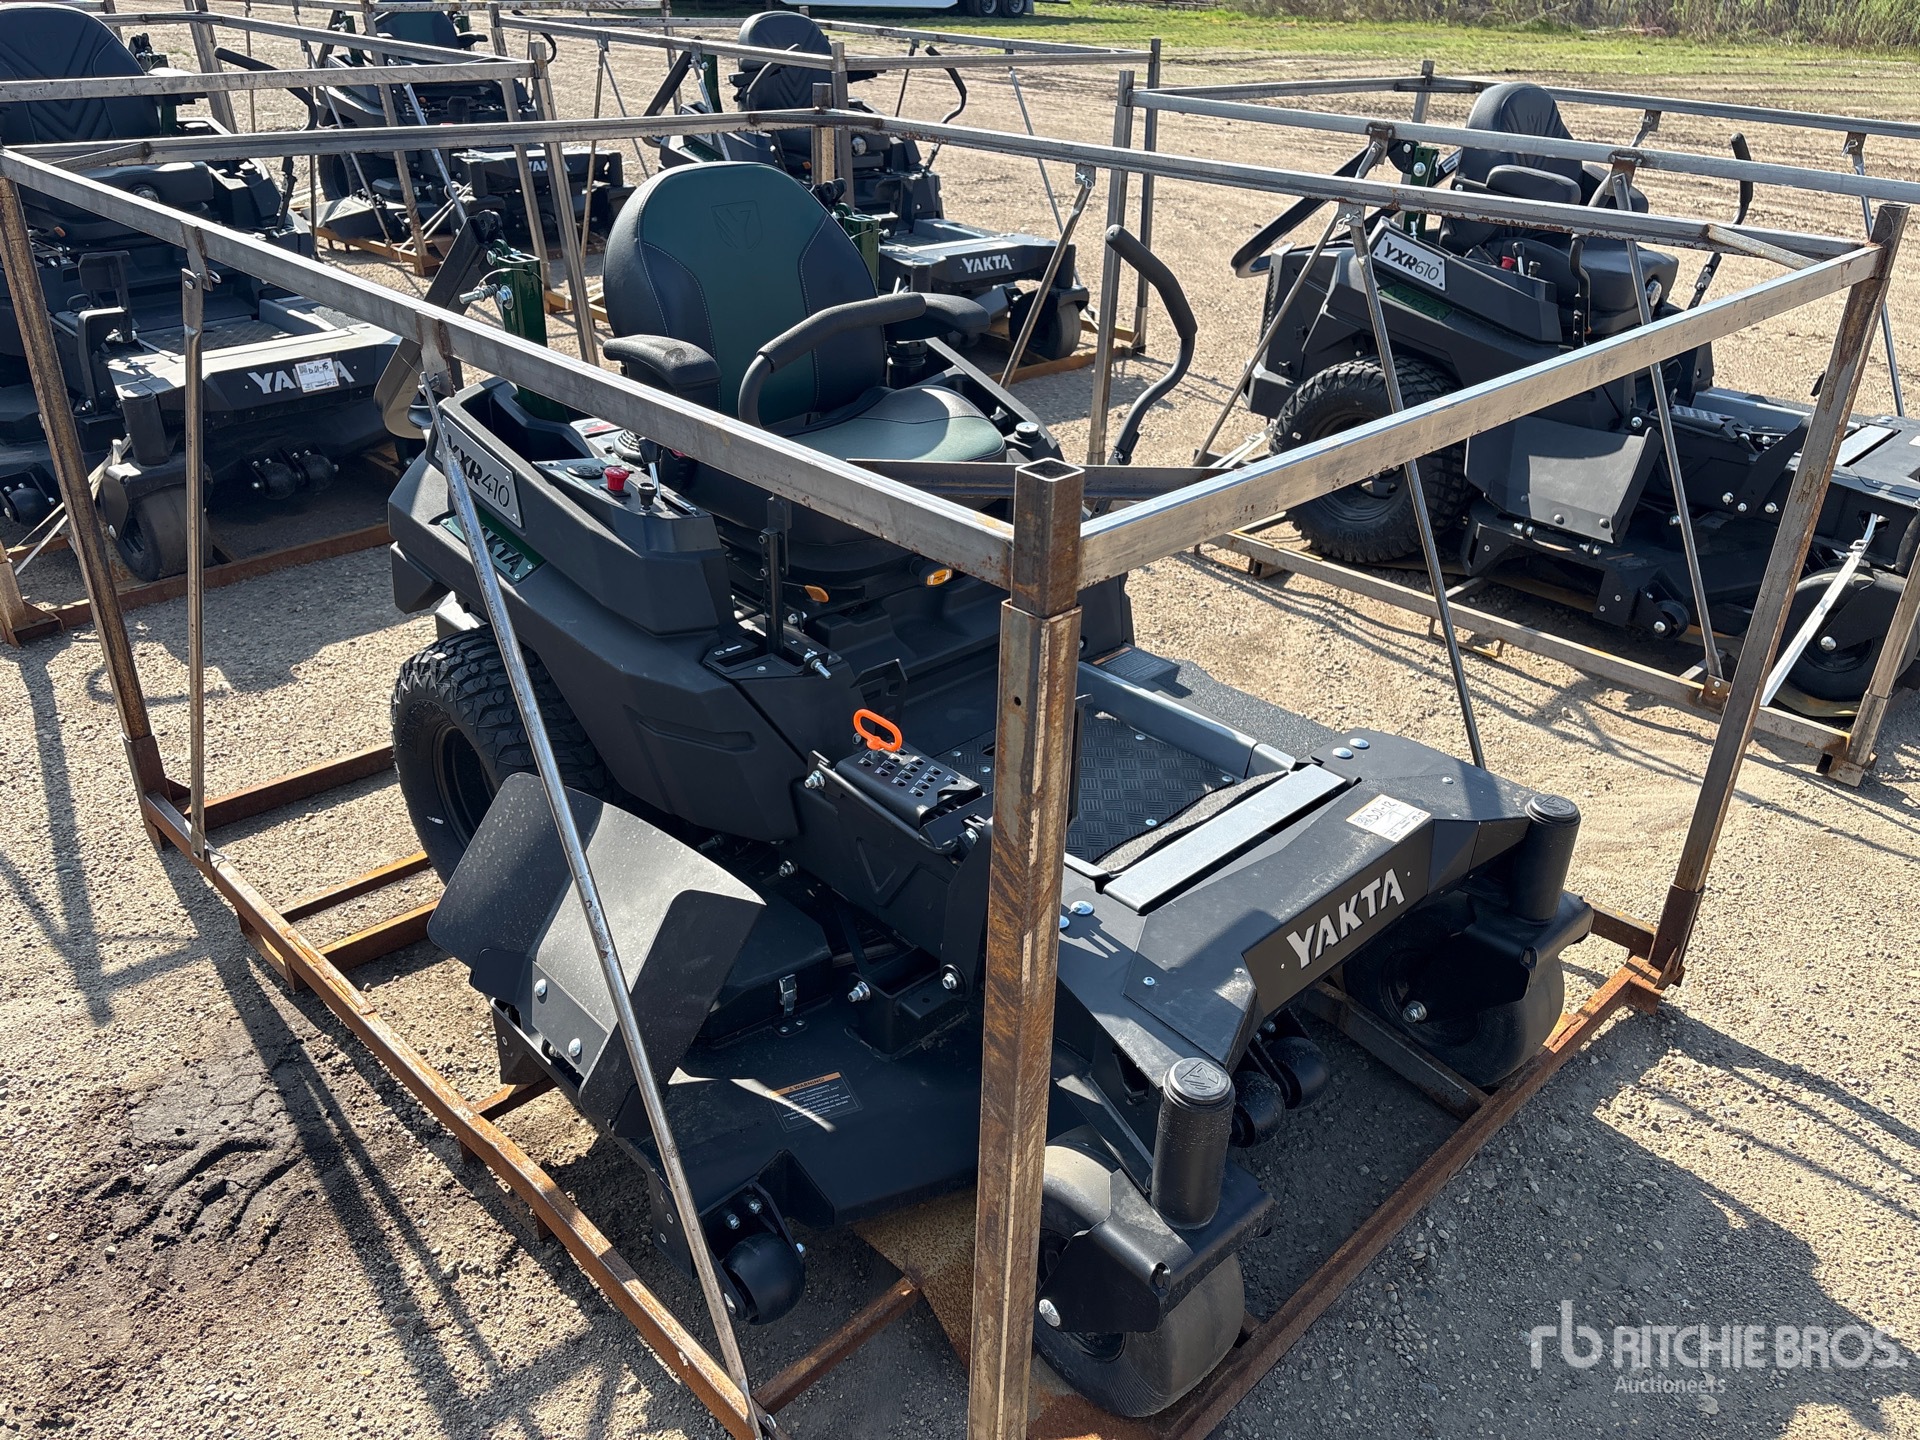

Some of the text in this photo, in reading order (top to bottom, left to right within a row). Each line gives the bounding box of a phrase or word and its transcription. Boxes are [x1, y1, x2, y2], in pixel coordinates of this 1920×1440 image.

[961, 253, 1013, 274] YAKTA
[1383, 241, 1440, 281] YXR610
[247, 360, 355, 395] YAA
[1286, 868, 1405, 970] YAKTA
